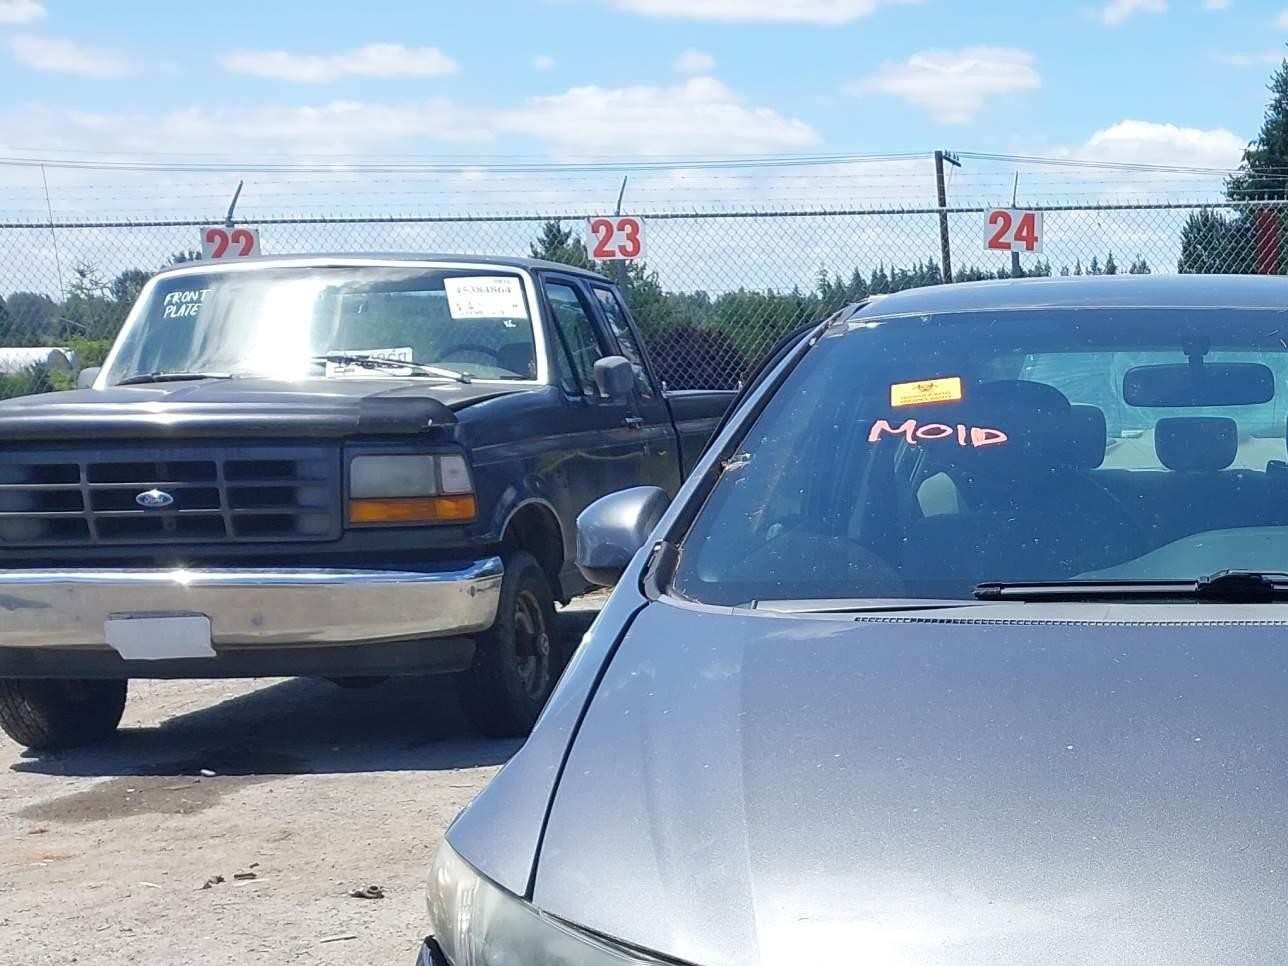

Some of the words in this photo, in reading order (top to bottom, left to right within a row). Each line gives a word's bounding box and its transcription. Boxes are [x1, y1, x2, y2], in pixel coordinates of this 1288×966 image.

[206, 228, 255, 259] 22
[591, 218, 641, 258] 23
[987, 210, 1039, 252] 24
[163, 288, 217, 306] FRONT
[163, 303, 203, 318] PLATE
